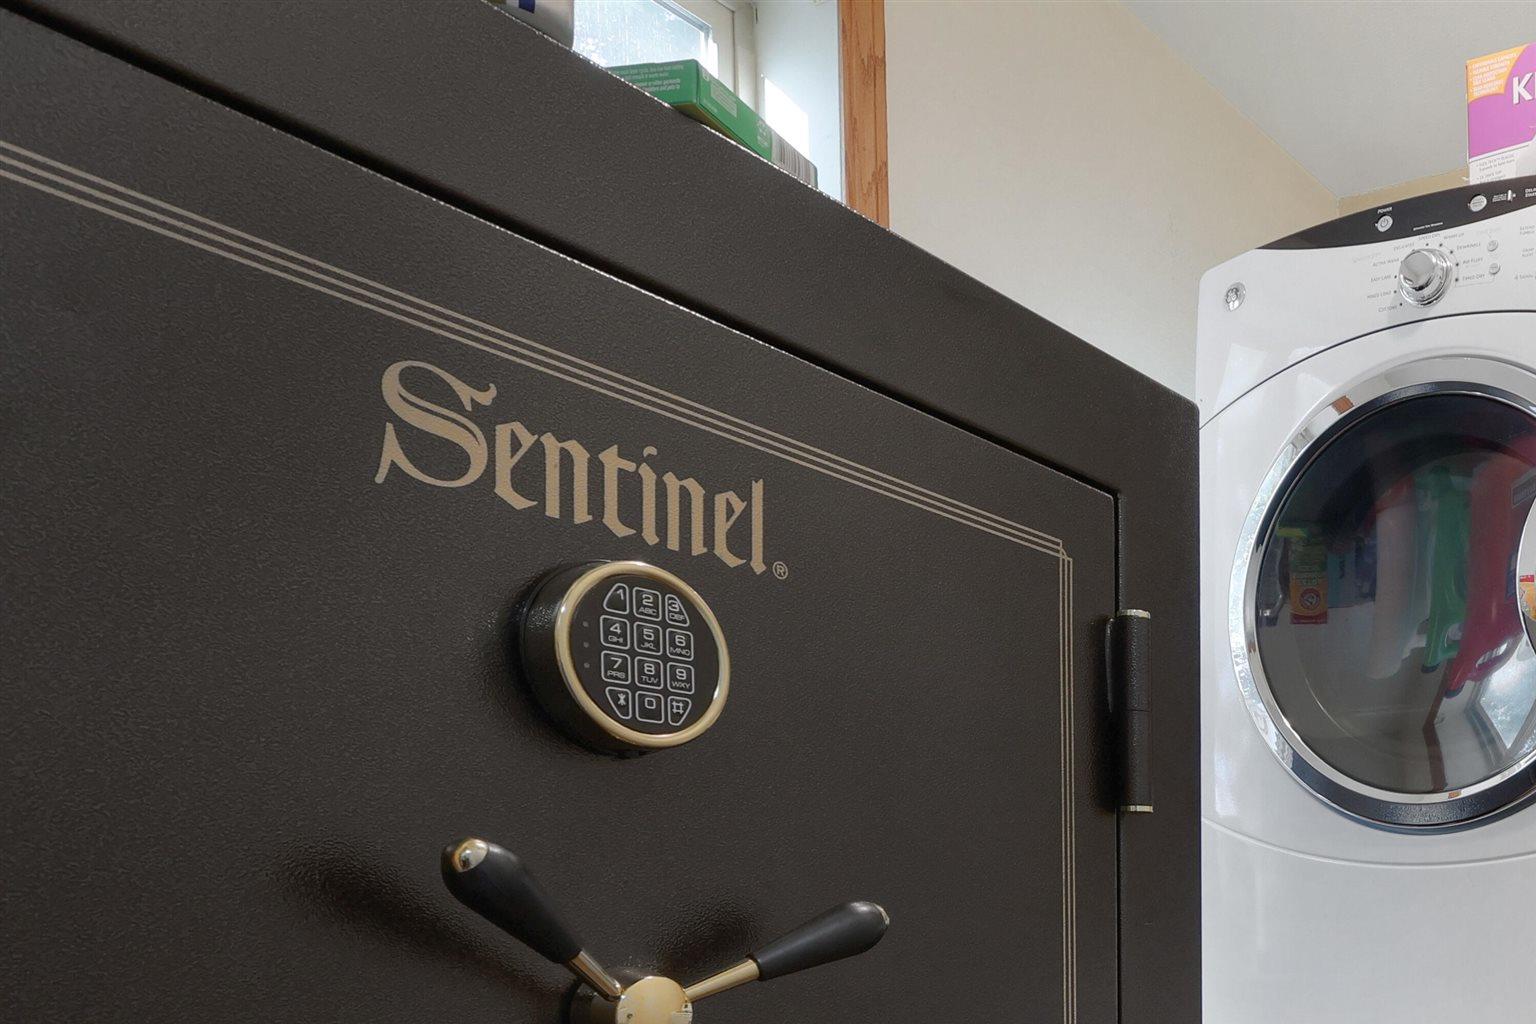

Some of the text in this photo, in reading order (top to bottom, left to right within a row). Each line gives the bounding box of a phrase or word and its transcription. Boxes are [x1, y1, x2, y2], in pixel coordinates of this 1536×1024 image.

[1377, 206, 1393, 214] POWER
[375, 360, 769, 576] Sentinel
[642, 594, 653, 606] 2
[668, 600, 680, 612] 3
[639, 607, 657, 616] ABC
[610, 623, 621, 634] 4
[643, 629, 654, 641] 5
[675, 635, 686, 647] 6
[610, 657, 622, 669] 7
[644, 663, 655, 675] 8
[675, 668, 687, 680] 9
